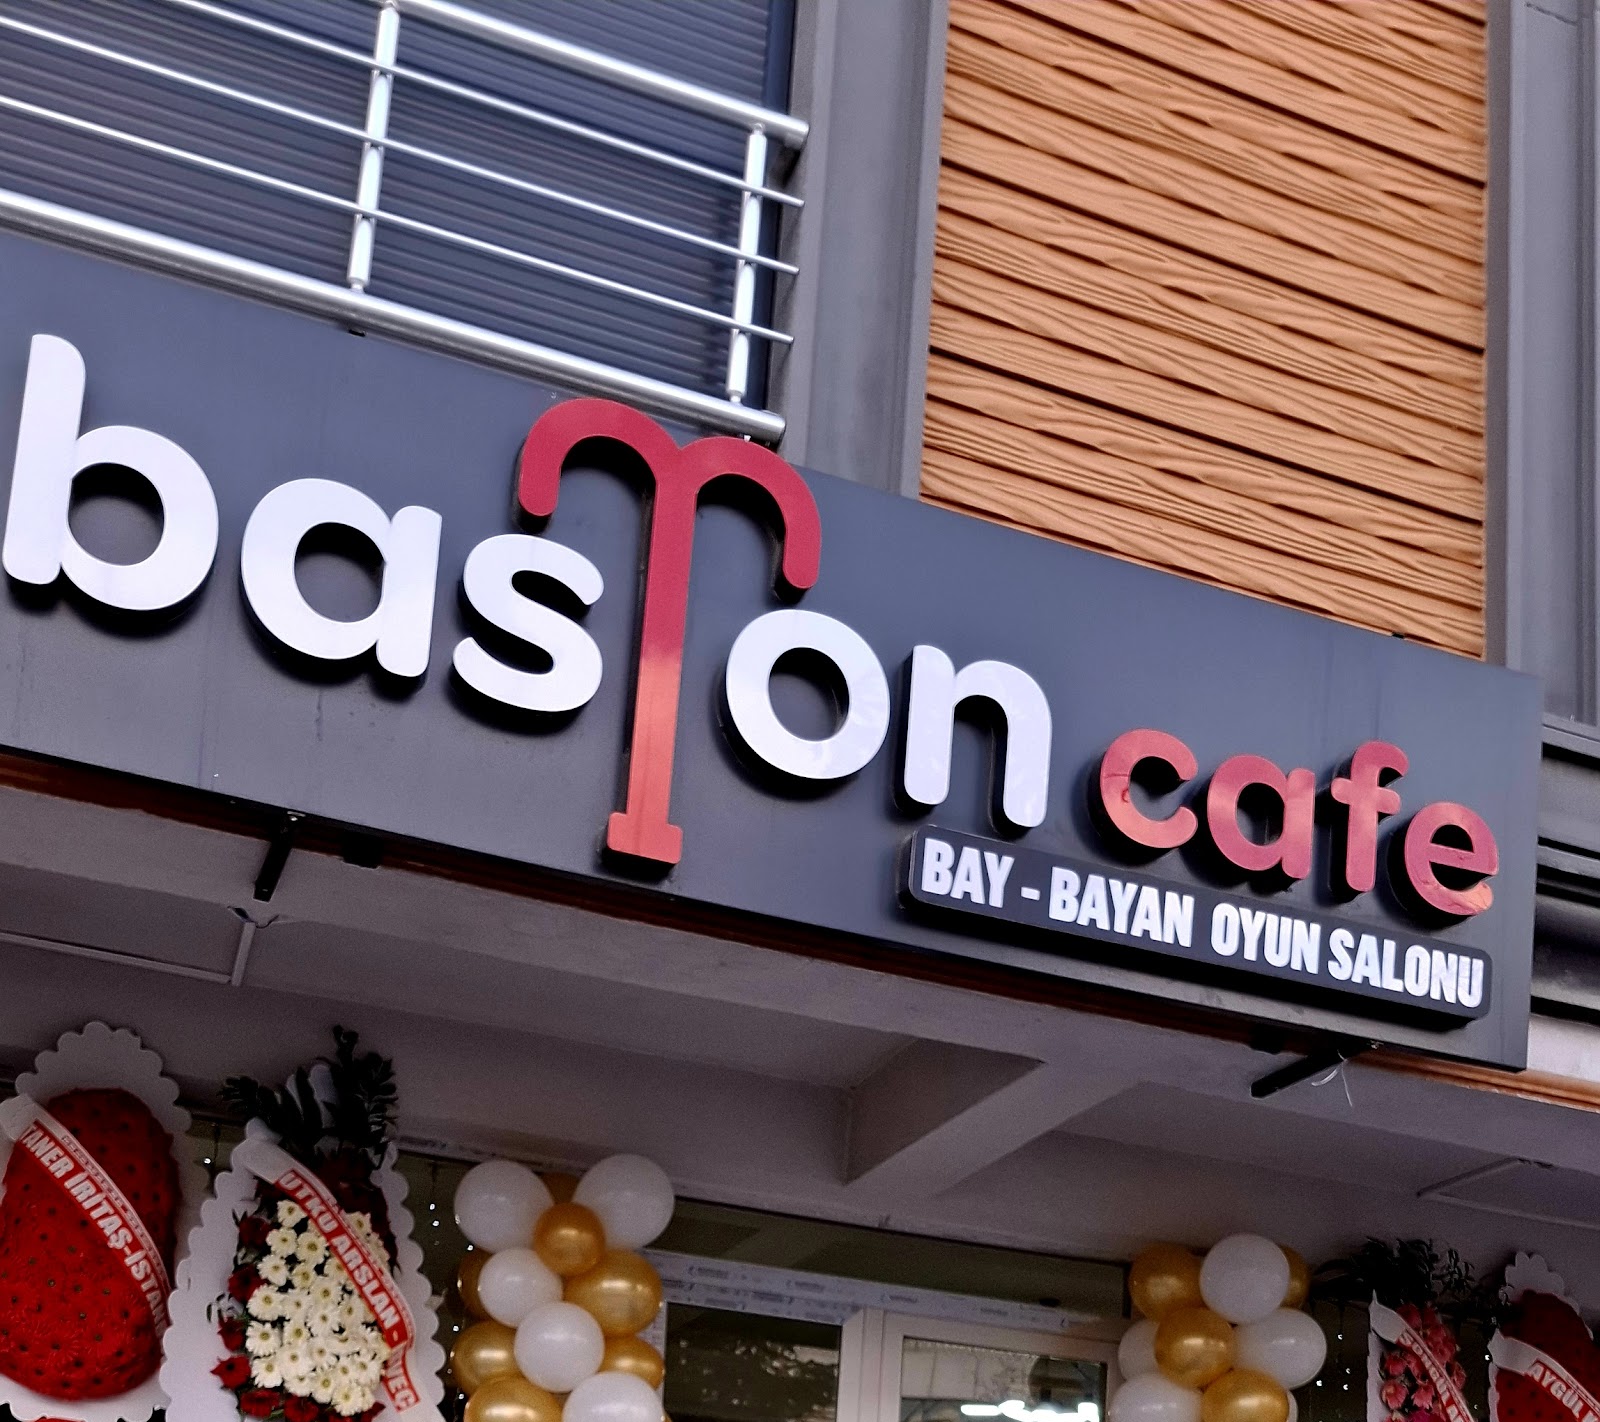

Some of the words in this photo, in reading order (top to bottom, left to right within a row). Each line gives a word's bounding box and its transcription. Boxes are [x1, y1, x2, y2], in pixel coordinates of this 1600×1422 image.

[1101, 728, 1499, 916] cafe
[921, 837, 1012, 910] BAY
[1049, 867, 1196, 948] BAYAN
[1210, 906, 1321, 974] OYUN
[1327, 930, 1484, 1009] SALONU
[20, 1124, 74, 1179] TANER
[279, 1172, 338, 1233] UTKU
[331, 1233, 399, 1330] ARSLAN
[1529, 1361, 1584, 1419] AYGÜL
